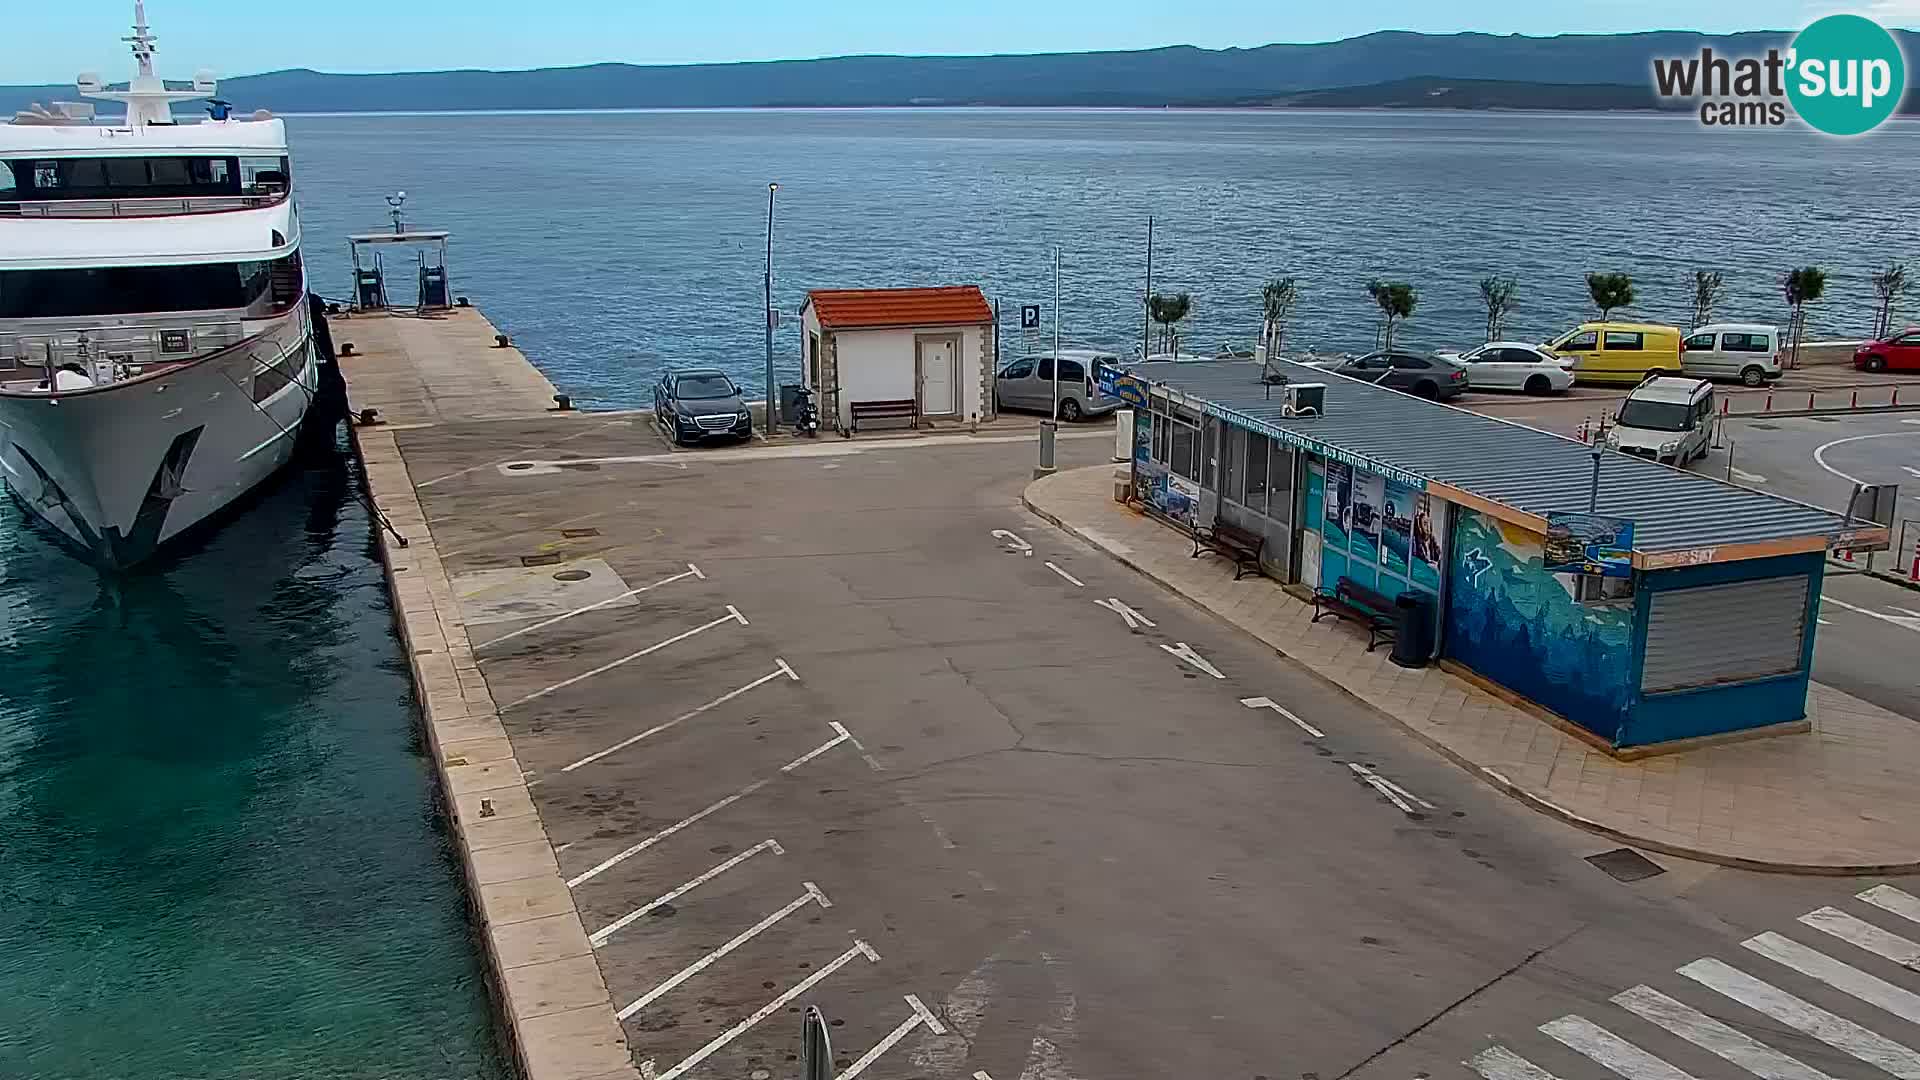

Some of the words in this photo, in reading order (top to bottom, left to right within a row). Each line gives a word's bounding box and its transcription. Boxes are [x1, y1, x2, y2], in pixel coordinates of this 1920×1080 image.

[1025, 308, 1036, 325] P
[1284, 431, 1314, 451] POSTAJA
[1322, 445, 1337, 459] BUS
[1337, 450, 1369, 470] STATION
[1370, 462, 1396, 480] TICKET
[1396, 471, 1424, 489] OFFICE
